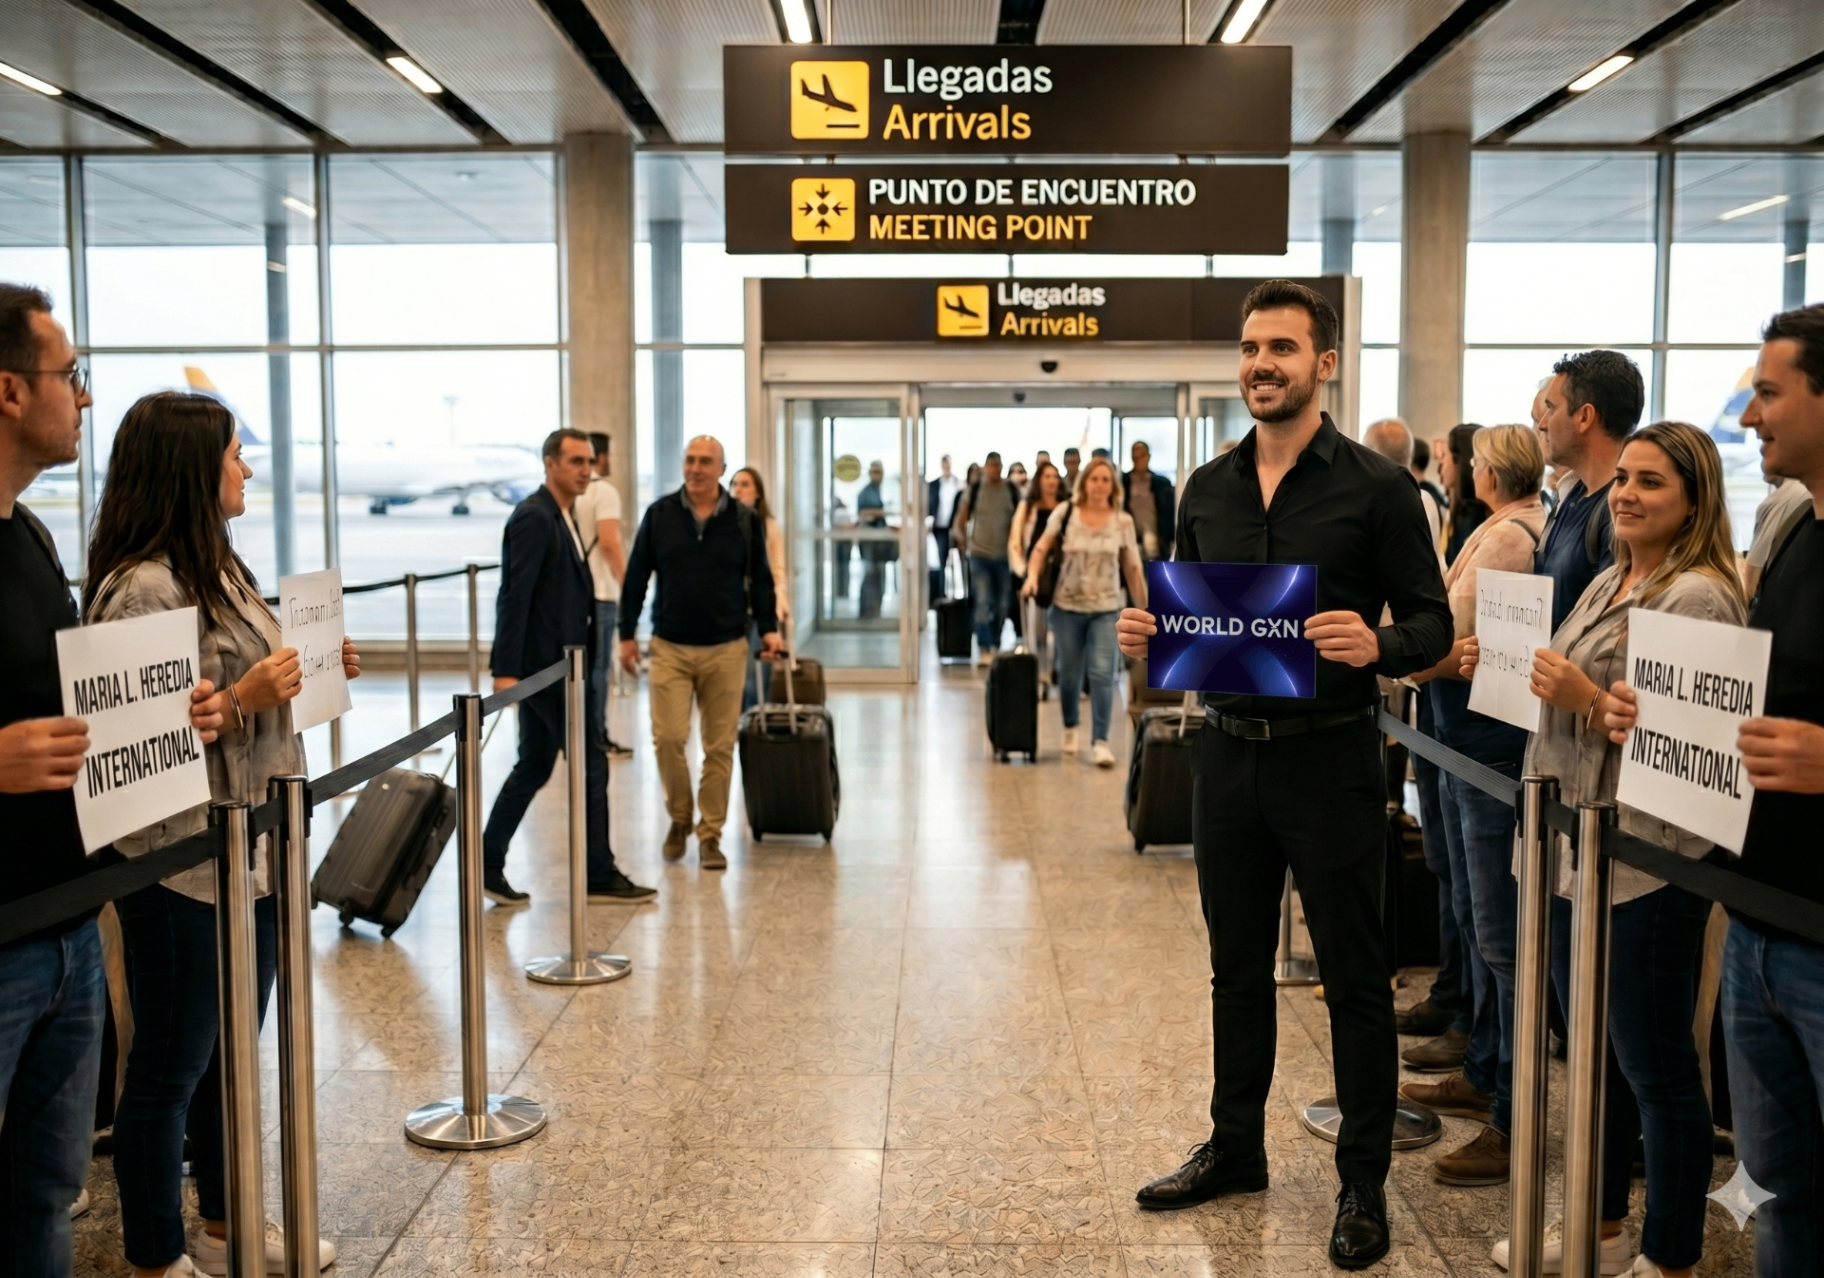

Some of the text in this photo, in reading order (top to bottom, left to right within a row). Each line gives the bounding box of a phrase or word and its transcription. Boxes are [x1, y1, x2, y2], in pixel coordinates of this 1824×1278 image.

[883, 58, 1052, 101] Llegadas
[882, 104, 1032, 140] Arrivals
[868, 178, 1196, 206] PUNTO DE ENCUENTRO
[869, 214, 1093, 241] MEETING POINT
[998, 282, 1106, 310] Llegadas
[1000, 312, 1099, 337] Arrivals
[1161, 614, 1299, 639] WORLD GXN
[74, 657, 194, 716] MARIA L. HEREDIA
[1634, 657, 1754, 717] MARIA L. HEREDIA
[85, 725, 200, 799] INTERNATIONAL
[1630, 726, 1742, 800] INTERNATIONAL
